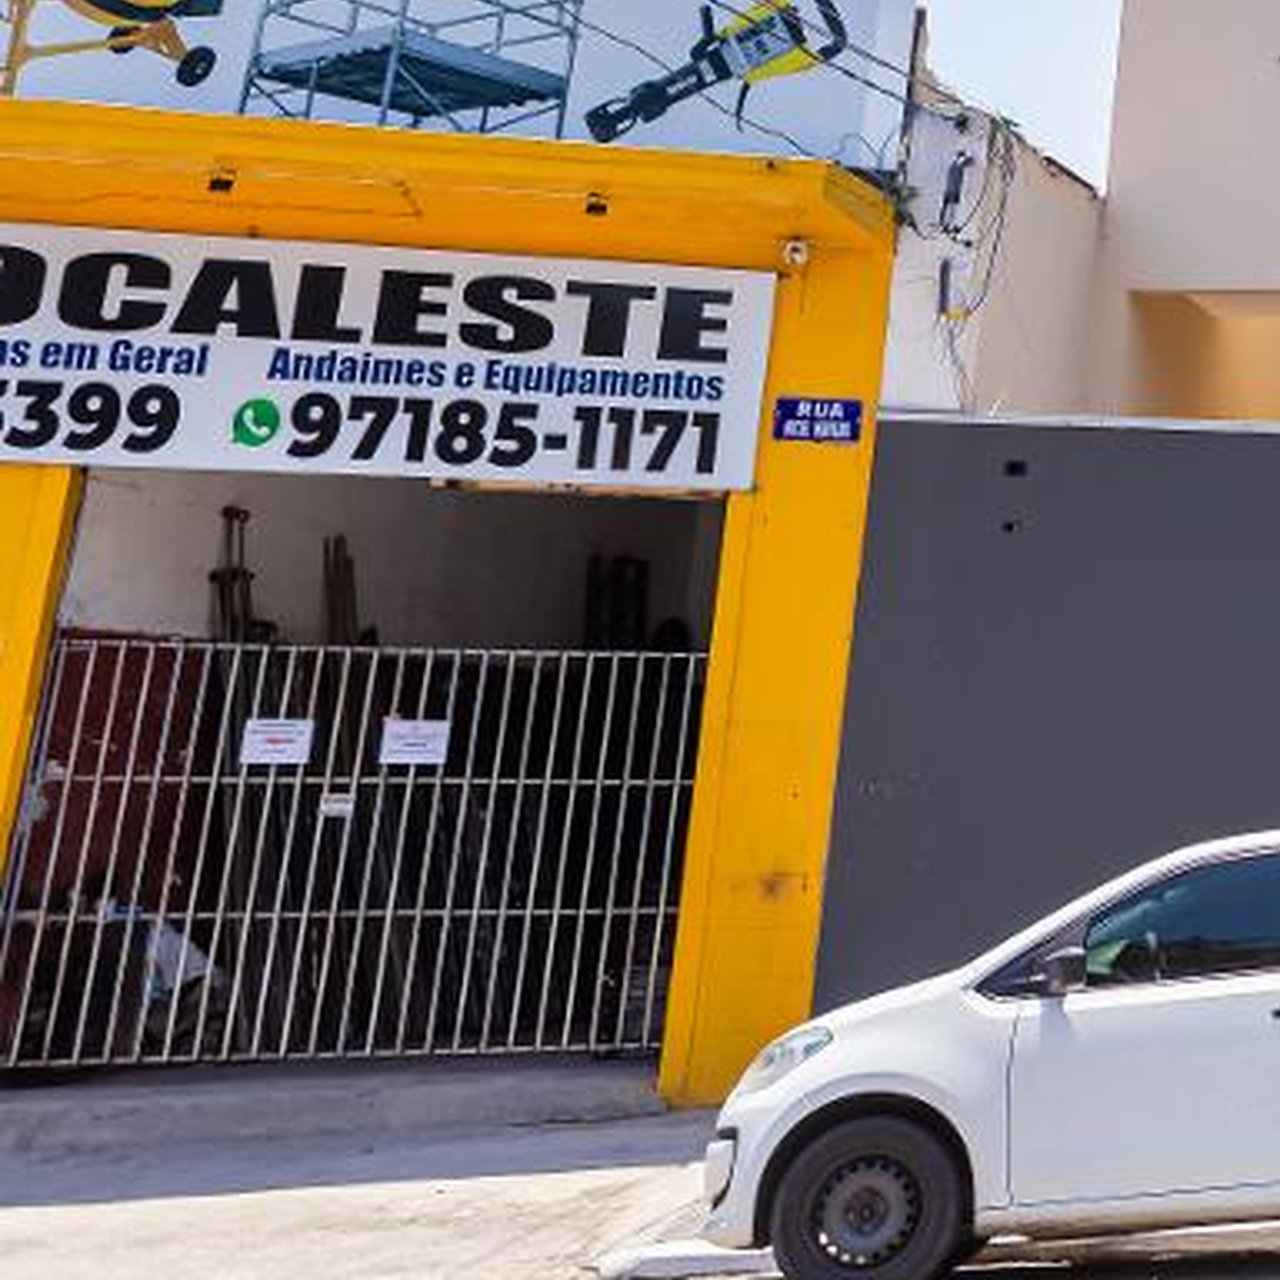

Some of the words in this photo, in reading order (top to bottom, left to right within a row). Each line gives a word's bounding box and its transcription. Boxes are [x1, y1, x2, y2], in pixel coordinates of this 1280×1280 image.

[39, 341, 98, 371] em
[109, 338, 210, 377] Geral
[267, 347, 447, 388] Andaimes
[453, 361, 475, 388] e
[484, 359, 724, 402] Equipamentos
[796, 400, 844, 418] RUA
[286, 392, 721, 475] 97185-1171
